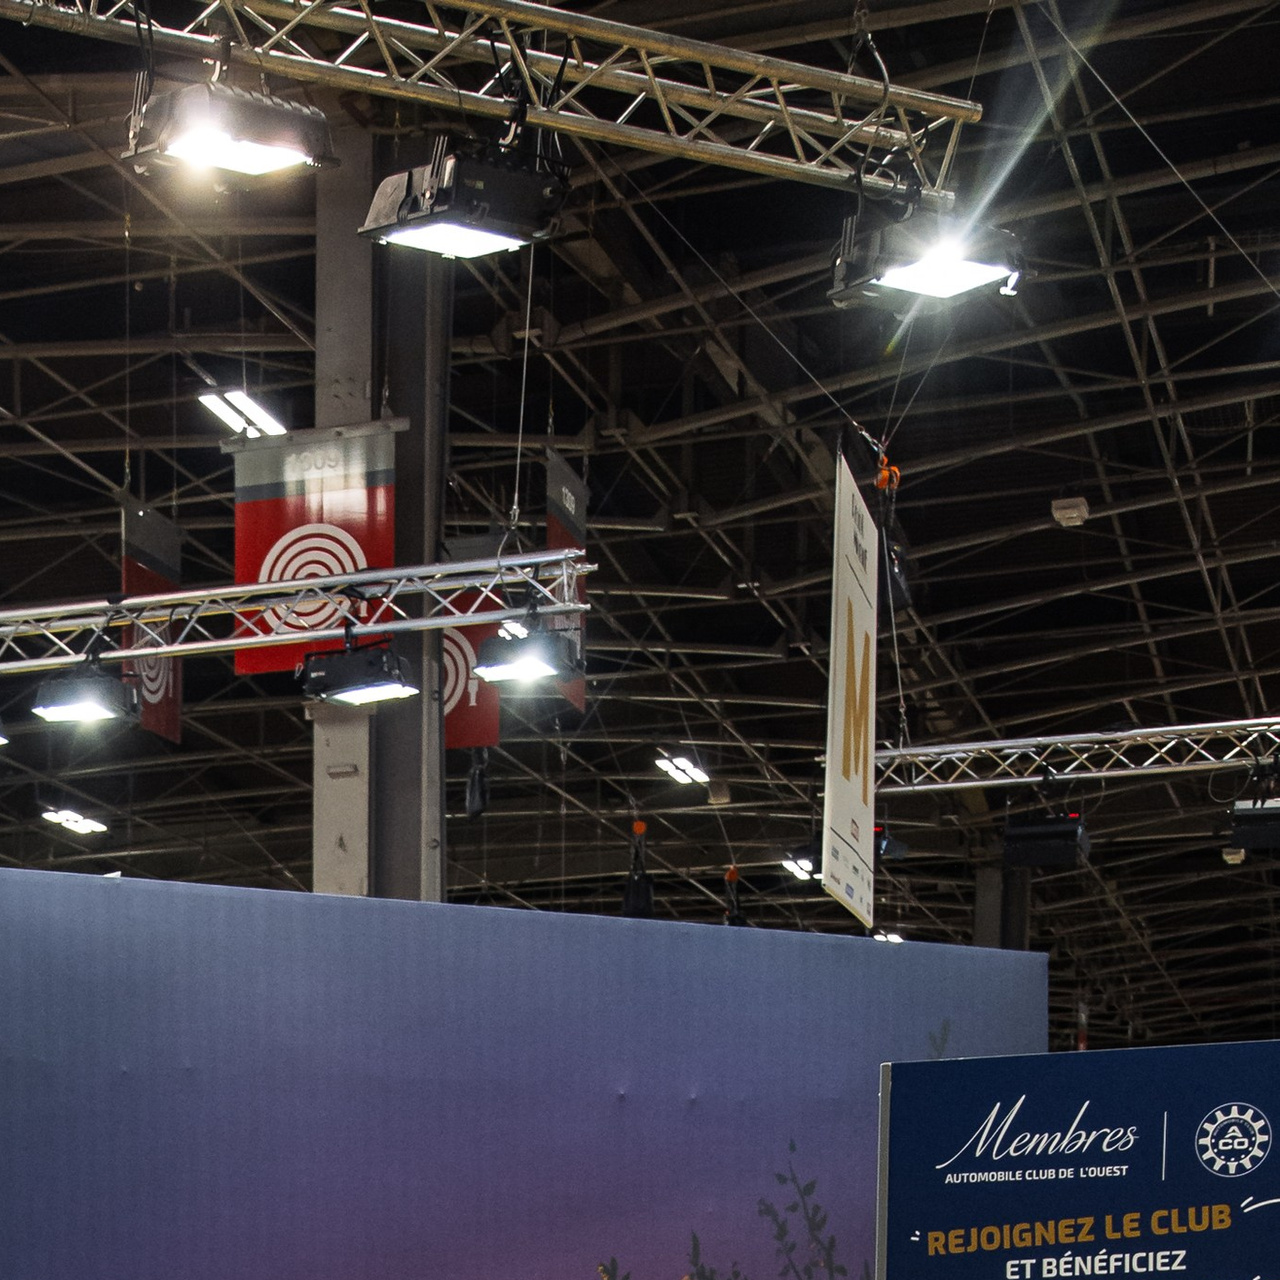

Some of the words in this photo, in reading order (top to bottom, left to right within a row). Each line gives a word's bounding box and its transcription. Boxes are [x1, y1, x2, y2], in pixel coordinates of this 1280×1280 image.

[841, 597, 872, 807] M
[936, 1095, 1139, 1169] Membres
[945, 1169, 1023, 1184] AUTOMOBILE
[1025, 1168, 1057, 1181] CLUB
[1058, 1168, 1075, 1180] DE
[1080, 1165, 1129, 1179] L'OUEST
[927, 1216, 1095, 1256] REJOIGNEZ
[1105, 1211, 1141, 1240] LE
[1151, 1204, 1232, 1236] CLUB
[1006, 1259, 1035, 1280] ET
[1043, 1248, 1186, 1277] BÉNÉFICIEZ
